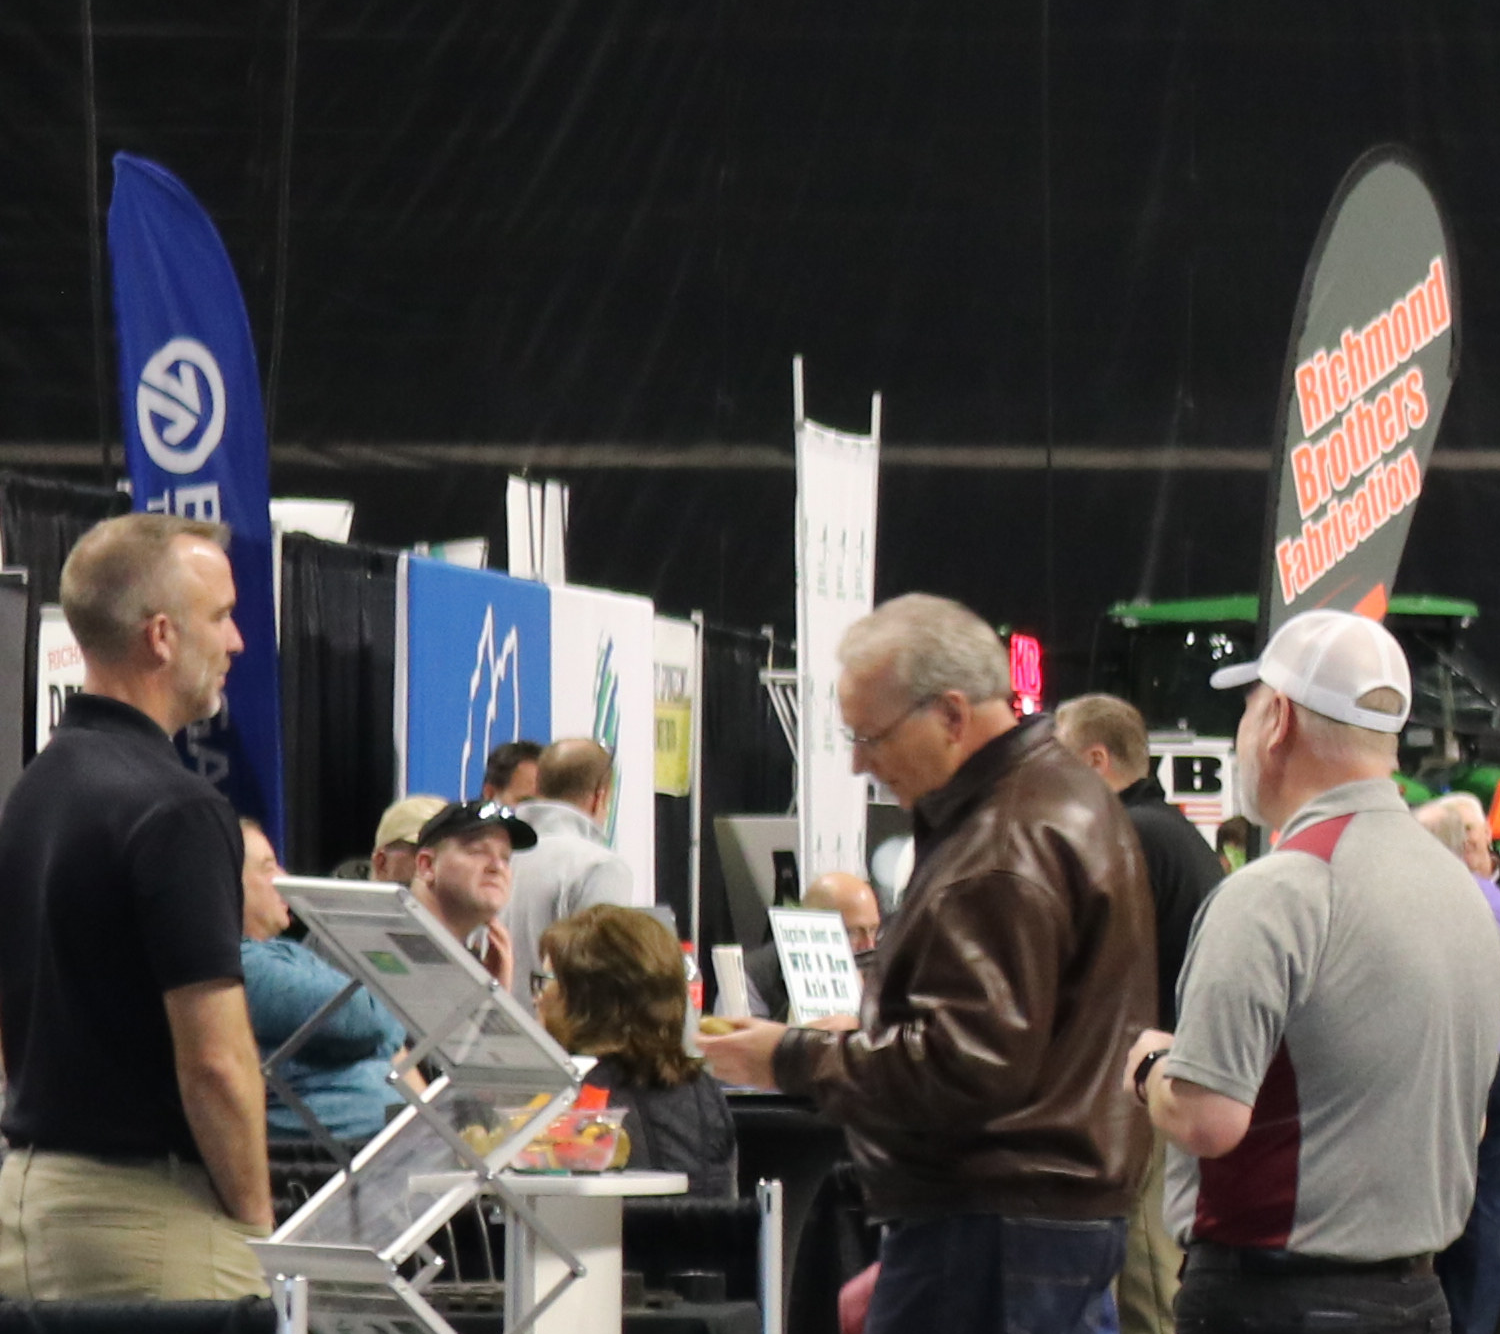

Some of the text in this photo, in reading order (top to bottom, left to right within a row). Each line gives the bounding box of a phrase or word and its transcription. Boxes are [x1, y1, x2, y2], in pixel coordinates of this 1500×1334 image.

[1295, 255, 1451, 438] Richmond
[1291, 364, 1428, 520] Brothers
[1276, 447, 1422, 606] Fabrication
